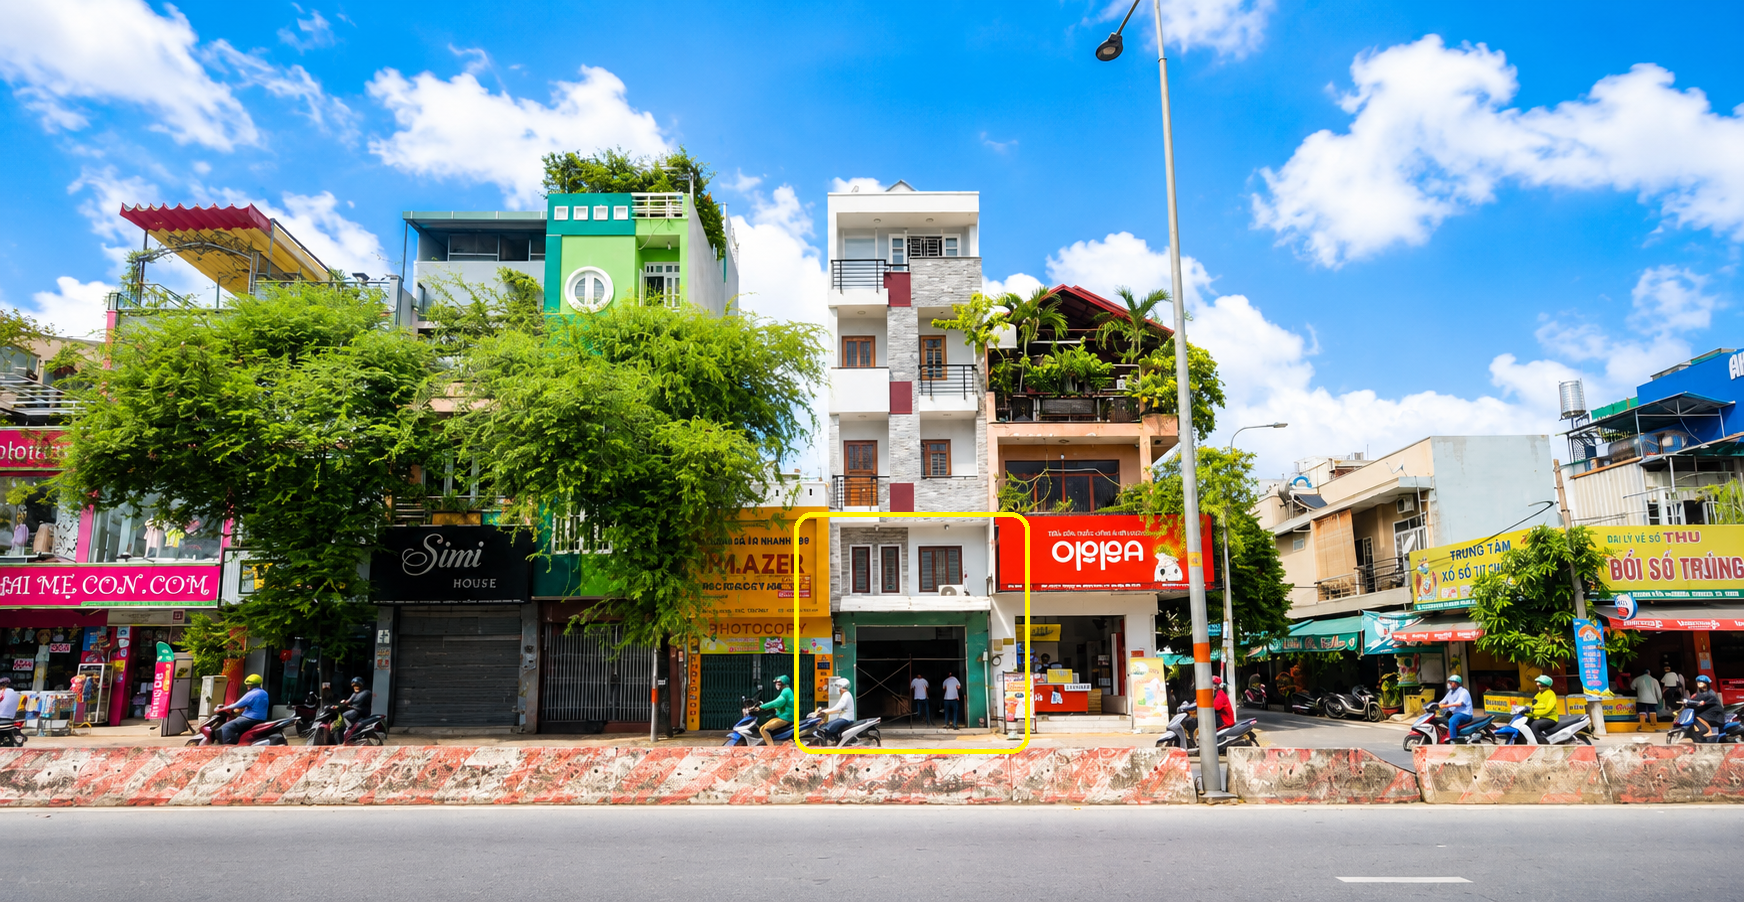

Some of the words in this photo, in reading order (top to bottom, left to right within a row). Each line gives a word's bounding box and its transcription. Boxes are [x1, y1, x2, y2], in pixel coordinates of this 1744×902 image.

[1663, 531, 1701, 544] THU
[402, 533, 484, 576] Simi
[1450, 544, 1485, 561] TRUNG
[453, 578, 497, 588] HOUSE
